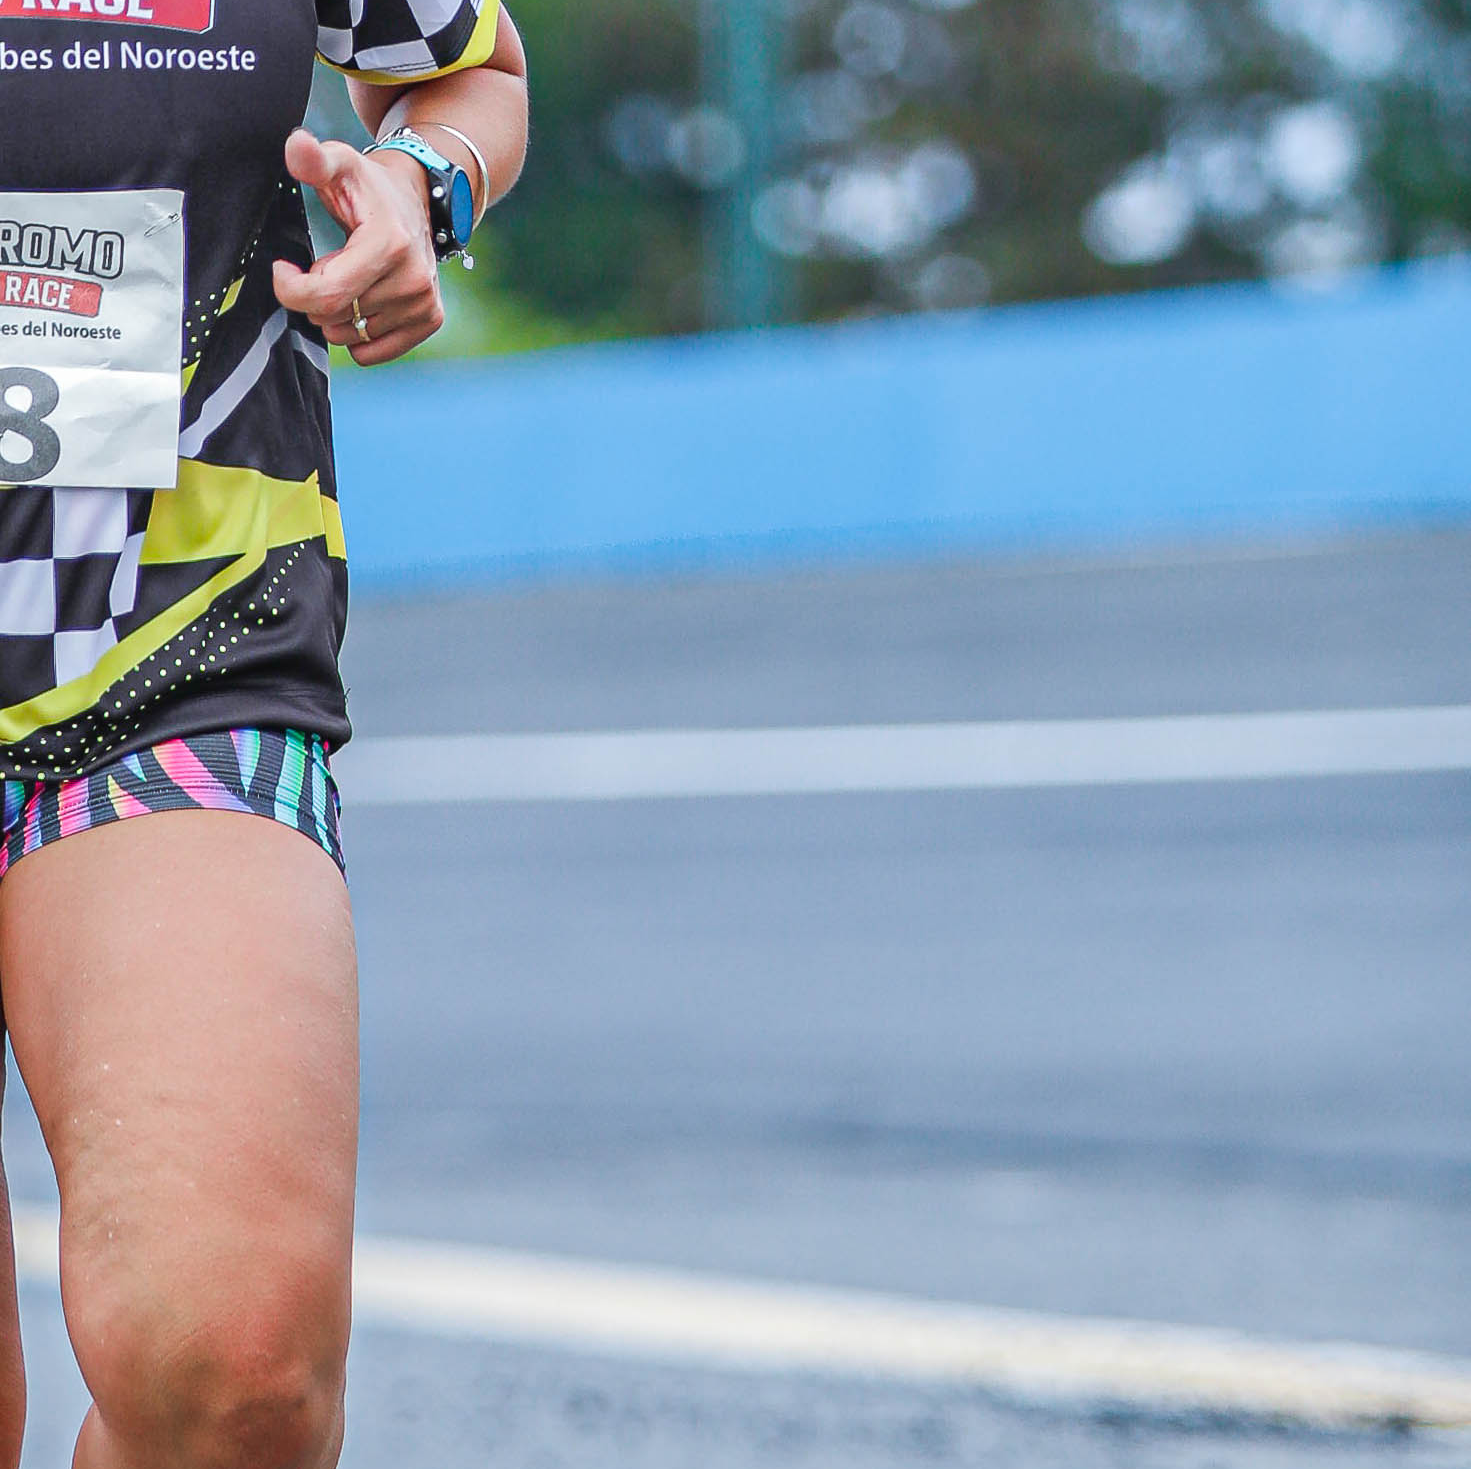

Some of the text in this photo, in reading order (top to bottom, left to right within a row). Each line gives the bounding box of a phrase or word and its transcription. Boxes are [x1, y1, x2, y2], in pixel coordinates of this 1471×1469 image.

[62, 40, 110, 70] del
[120, 41, 256, 71] Noroeste
[5, 274, 74, 311] RACE
[22, 320, 47, 337] del
[51, 321, 122, 340] Noroeste
